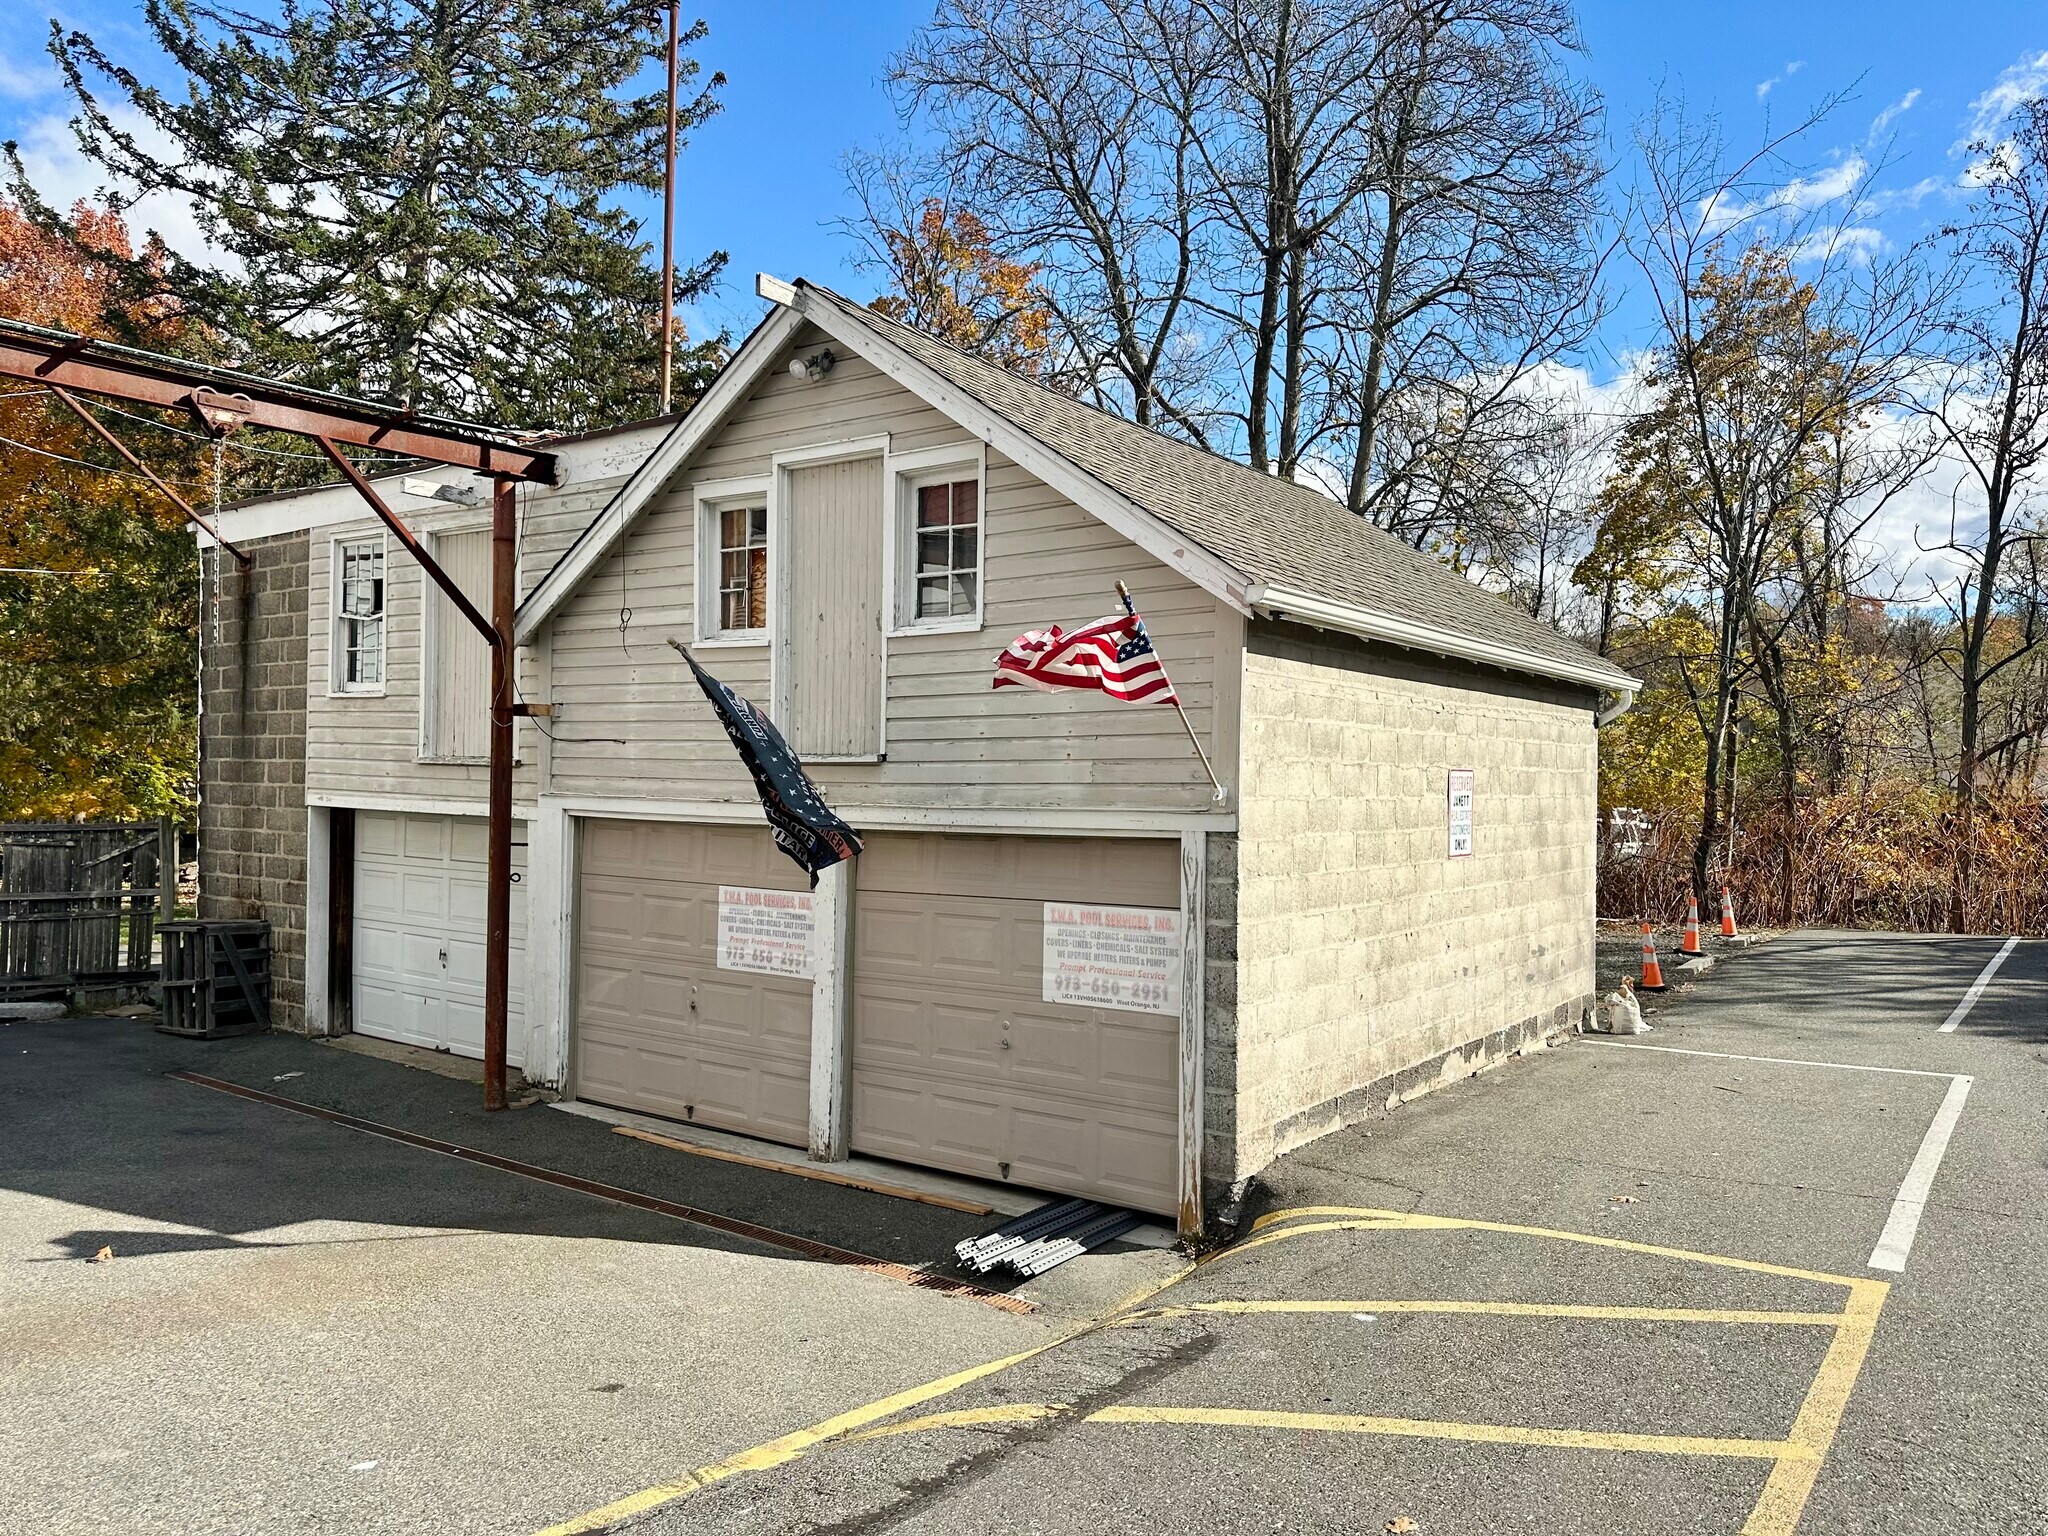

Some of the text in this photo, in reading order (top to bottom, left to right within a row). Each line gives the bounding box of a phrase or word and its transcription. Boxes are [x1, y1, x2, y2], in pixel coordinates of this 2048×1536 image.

[1451, 775, 1472, 791] RESERVED
[745, 891, 762, 906] POOL
[720, 915, 815, 931] COVERS LINERS CHEMICALS SALT SYSTEMS
[1080, 910, 1103, 927] POOL
[1105, 913, 1152, 932] SERVICES,
[1154, 916, 1176, 932] INC.
[728, 925, 735, 933] WE
[736, 926, 754, 935] UPGRADE
[772, 929, 787, 939] FILTERS
[791, 932, 806, 941] PUMPS
[1057, 928, 1167, 945] OPENINGS CLOSINGS MAINTENANCE
[729, 935, 805, 950] Prompt Professional Service
[1046, 937, 1179, 958] COVERS LINERS CHEMICALS SALT SYSTEMS
[1057, 950, 1066, 959] WE
[1067, 951, 1092, 961] UPGRADE
[1119, 956, 1140, 967] FILTERS
[1146, 958, 1167, 968] PUMPS
[1059, 962, 1166, 981] Prompt Professional Service
[1054, 974, 1170, 1002] 973-650-2951
[1116, 999, 1131, 1007] West
[1131, 1000, 1152, 1010] Orange,
